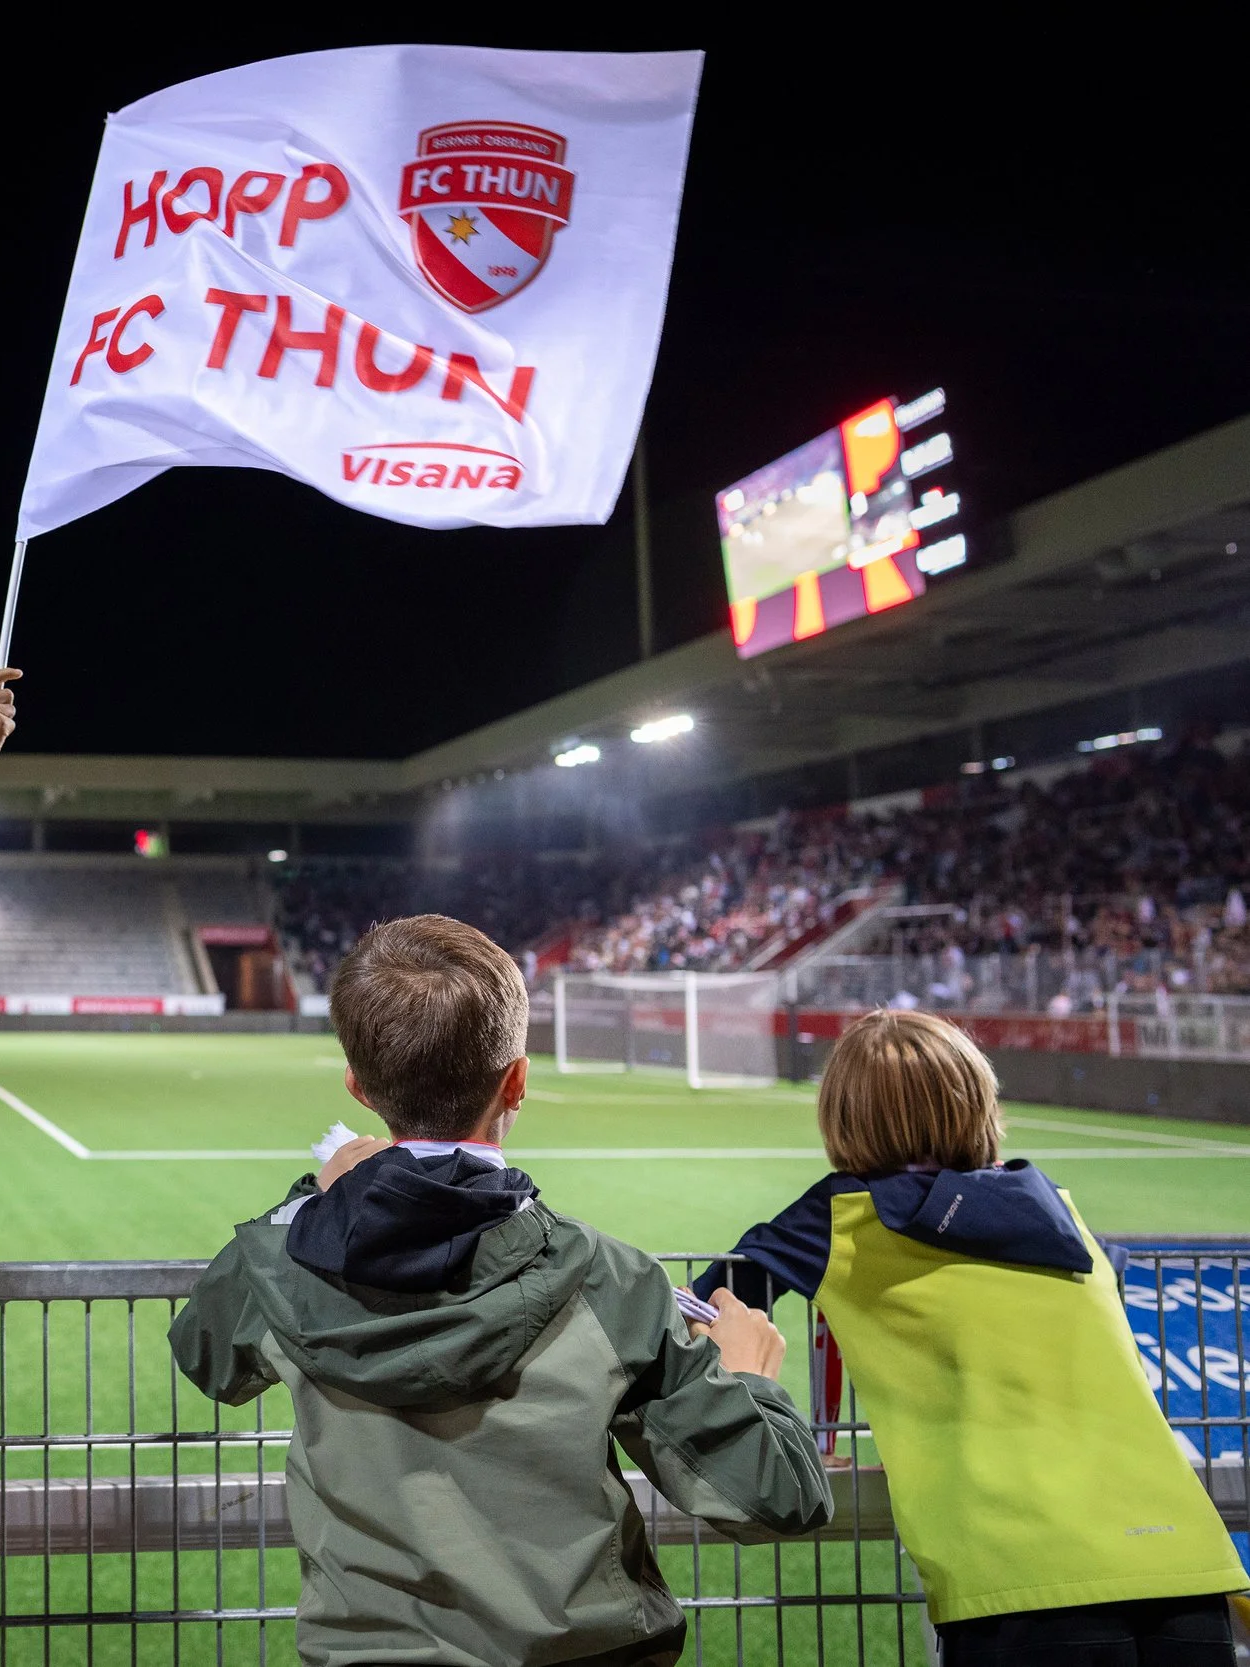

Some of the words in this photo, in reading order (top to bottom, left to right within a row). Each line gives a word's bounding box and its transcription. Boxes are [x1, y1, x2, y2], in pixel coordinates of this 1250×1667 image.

[115, 163, 350, 258] HOPP
[411, 165, 454, 199] FC
[461, 165, 563, 207] THUN
[71, 294, 165, 385] FC
[206, 287, 536, 424] THUN
